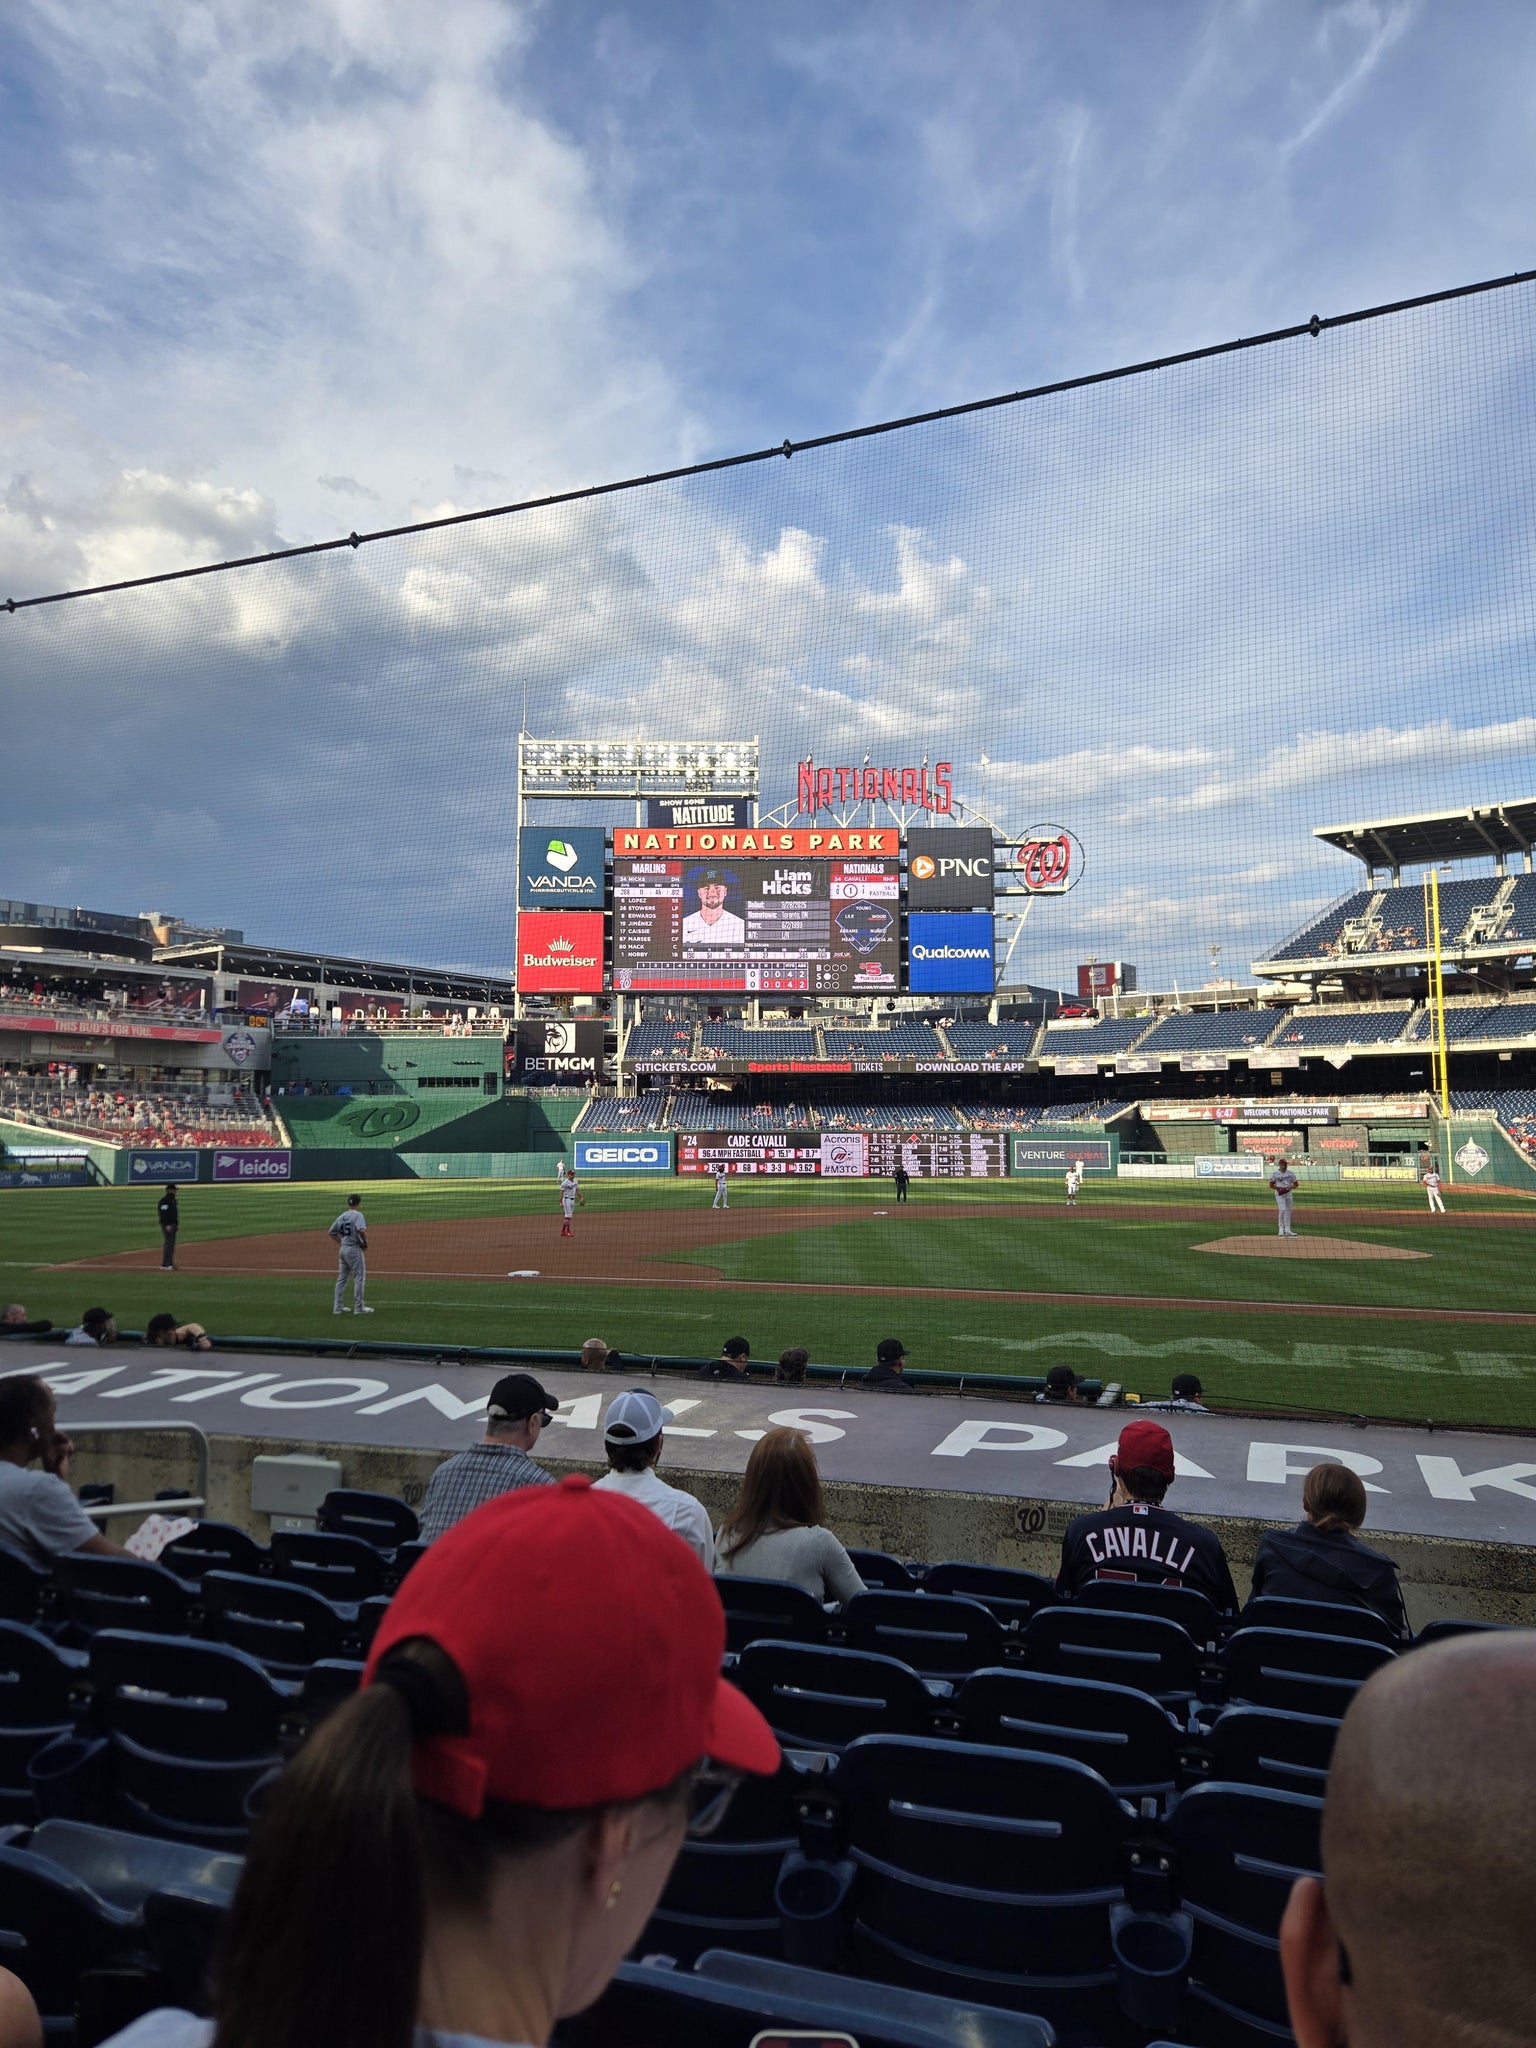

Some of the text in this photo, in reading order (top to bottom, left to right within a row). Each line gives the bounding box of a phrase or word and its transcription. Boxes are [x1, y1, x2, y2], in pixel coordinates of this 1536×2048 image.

[798, 762, 951, 813] NATIONALS
[660, 798, 706, 807] SHOW SOME
[672, 805, 736, 825] NATITUDE
[623, 834, 885, 851] NATIONALS PARK
[632, 863, 667, 875] MARLINS
[843, 863, 885, 875] NATIONALS
[937, 858, 990, 877] PNC
[774, 869, 812, 882] Liam
[526, 876, 598, 888] VANDA
[762, 881, 812, 895] Hicks
[912, 944, 991, 961] Qualcomm
[522, 952, 598, 968] Budweiser
[750, 970, 805, 978] 0 0 0 4 2
[55, 1020, 78, 1032] THIS
[79, 1021, 109, 1034] BUD'S
[110, 1023, 130, 1035] FOR
[525, 1057, 595, 1071] BETMGM
[634, 1061, 716, 1072] SITICKETS.COM
[747, 1060, 789, 1073] Sports
[853, 1061, 884, 1072] TICKETS
[914, 1061, 982, 1072] DOWNLOAD
[983, 1061, 1001, 1072] THE
[1002, 1061, 1025, 1072] APP
[1215, 1109, 1234, 1119] 6:47
[1243, 1109, 1271, 1118] WELCOME
[1271, 1109, 1280, 1117] TO
[1280, 1108, 1312, 1118] NATIONALS
[1313, 1107, 1329, 1117] PARK
[683, 1135, 787, 1148] #24 CADE CAVALLI
[823, 1135, 861, 1144] Acronis
[1243, 1137, 1293, 1146] powered by
[1319, 1138, 1358, 1149] verizon
[585, 1148, 658, 1163] GEICO
[702, 1150, 717, 1158] 96.4
[717, 1150, 732, 1158] MPH
[732, 1150, 761, 1158] FASTBALL
[1020, 1151, 1105, 1161] VENTURE GLOBAL
[147, 1160, 194, 1170] VANDA
[239, 1158, 288, 1175] leidos
[1404, 1157, 1415, 1166] 335
[770, 1164, 782, 1172] 3-3
[798, 1164, 813, 1172] 3.62
[823, 1166, 858, 1174] #M3TC
[1387, 1169, 1414, 1179] FENCE
[340, 1223, 352, 1237] 45
[1048, 1517, 1067, 1525] ITEMS
[1085, 1527, 1196, 1573] CAVALLI
